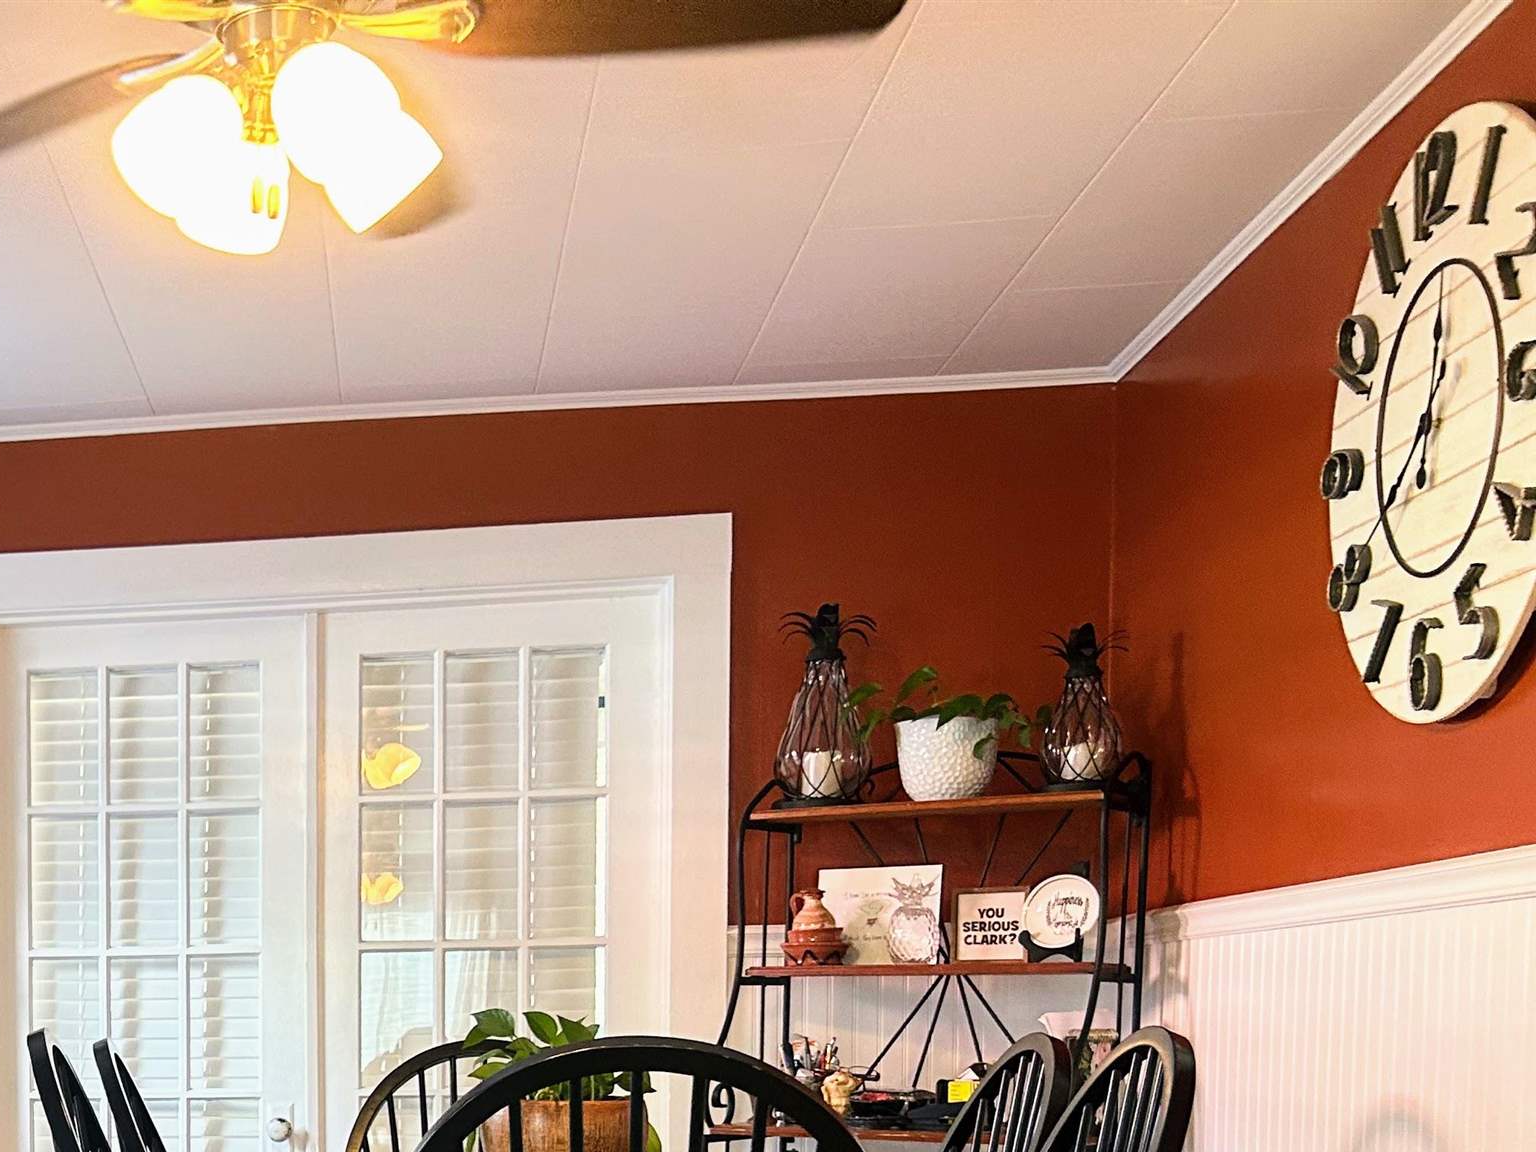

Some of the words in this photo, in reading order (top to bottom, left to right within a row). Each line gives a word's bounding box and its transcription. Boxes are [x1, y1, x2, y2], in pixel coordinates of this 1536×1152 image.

[1413, 130, 1459, 242] 12
[1467, 124, 1508, 225] 1
[1368, 202, 1412, 298] 11
[1329, 314, 1380, 401] 10
[1327, 544, 1372, 612] 8
[1454, 562, 1500, 660] 5
[1361, 599, 1404, 684] 7
[1409, 617, 1444, 711] 6
[963, 920, 1020, 932] SERIOUS
[964, 933, 1017, 946] CLARK?
[978, 908, 1005, 919] YOU
